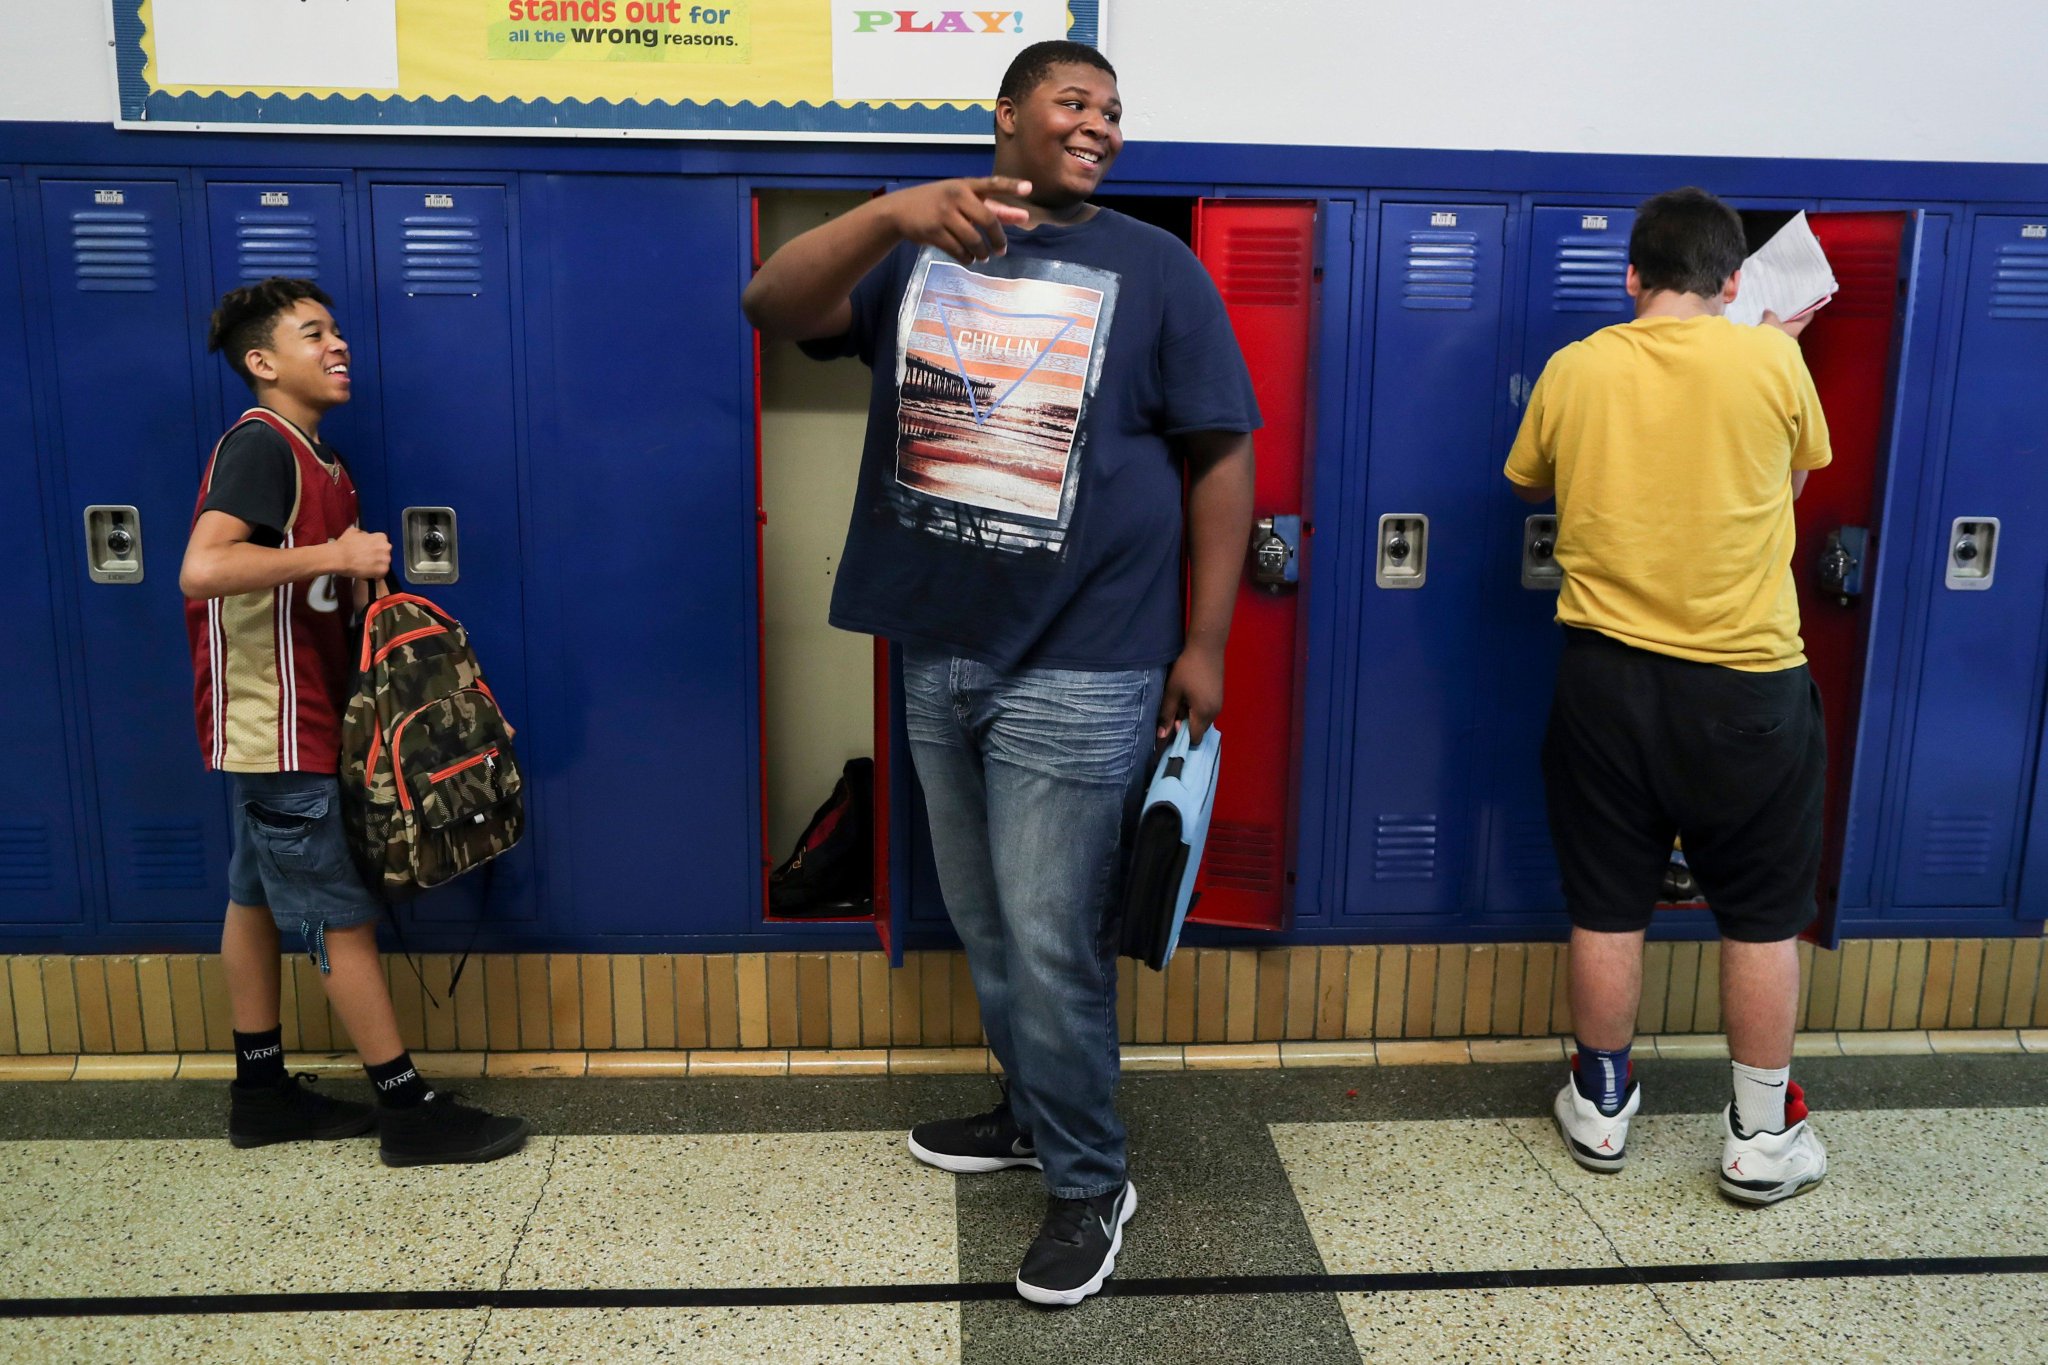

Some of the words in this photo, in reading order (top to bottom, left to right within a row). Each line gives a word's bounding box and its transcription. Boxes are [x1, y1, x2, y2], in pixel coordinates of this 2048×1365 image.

[509, 0, 617, 22] stands
[625, 0, 681, 24] out
[689, 6, 730, 24] for
[852, 10, 1024, 34] PLAY!
[508, 29, 529, 42] all
[534, 30, 565, 43] the
[571, 27, 658, 47] wrong
[664, 33, 738, 46] reasons.
[957, 330, 1039, 358] CHILLIN
[243, 1044, 280, 1061] VANS
[377, 1068, 416, 1091] VANS
